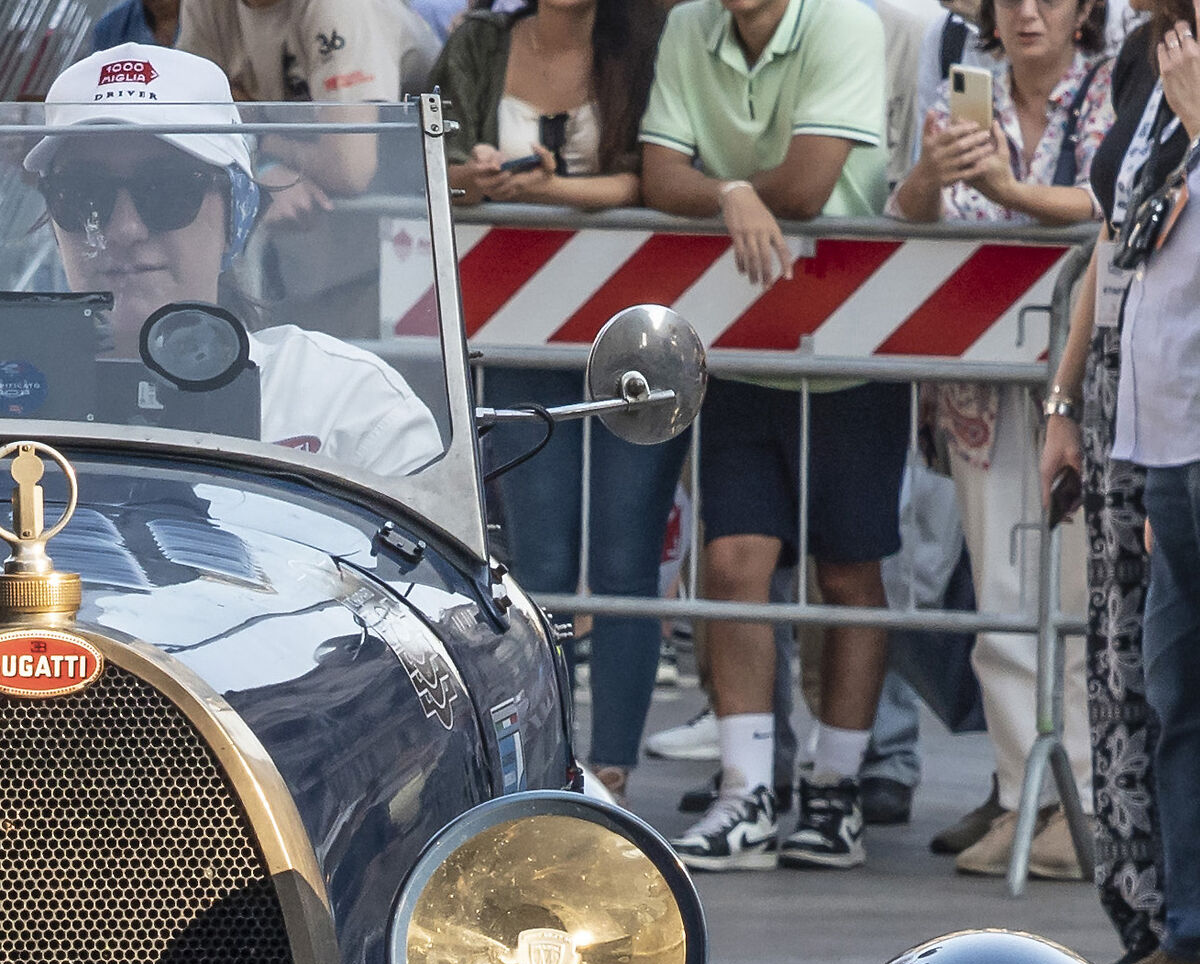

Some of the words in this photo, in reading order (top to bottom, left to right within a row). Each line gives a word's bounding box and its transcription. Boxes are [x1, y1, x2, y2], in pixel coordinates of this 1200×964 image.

[105, 62, 145, 73] 1000
[100, 73, 146, 85] MIGLIA
[94, 90, 158, 101] DRIVER
